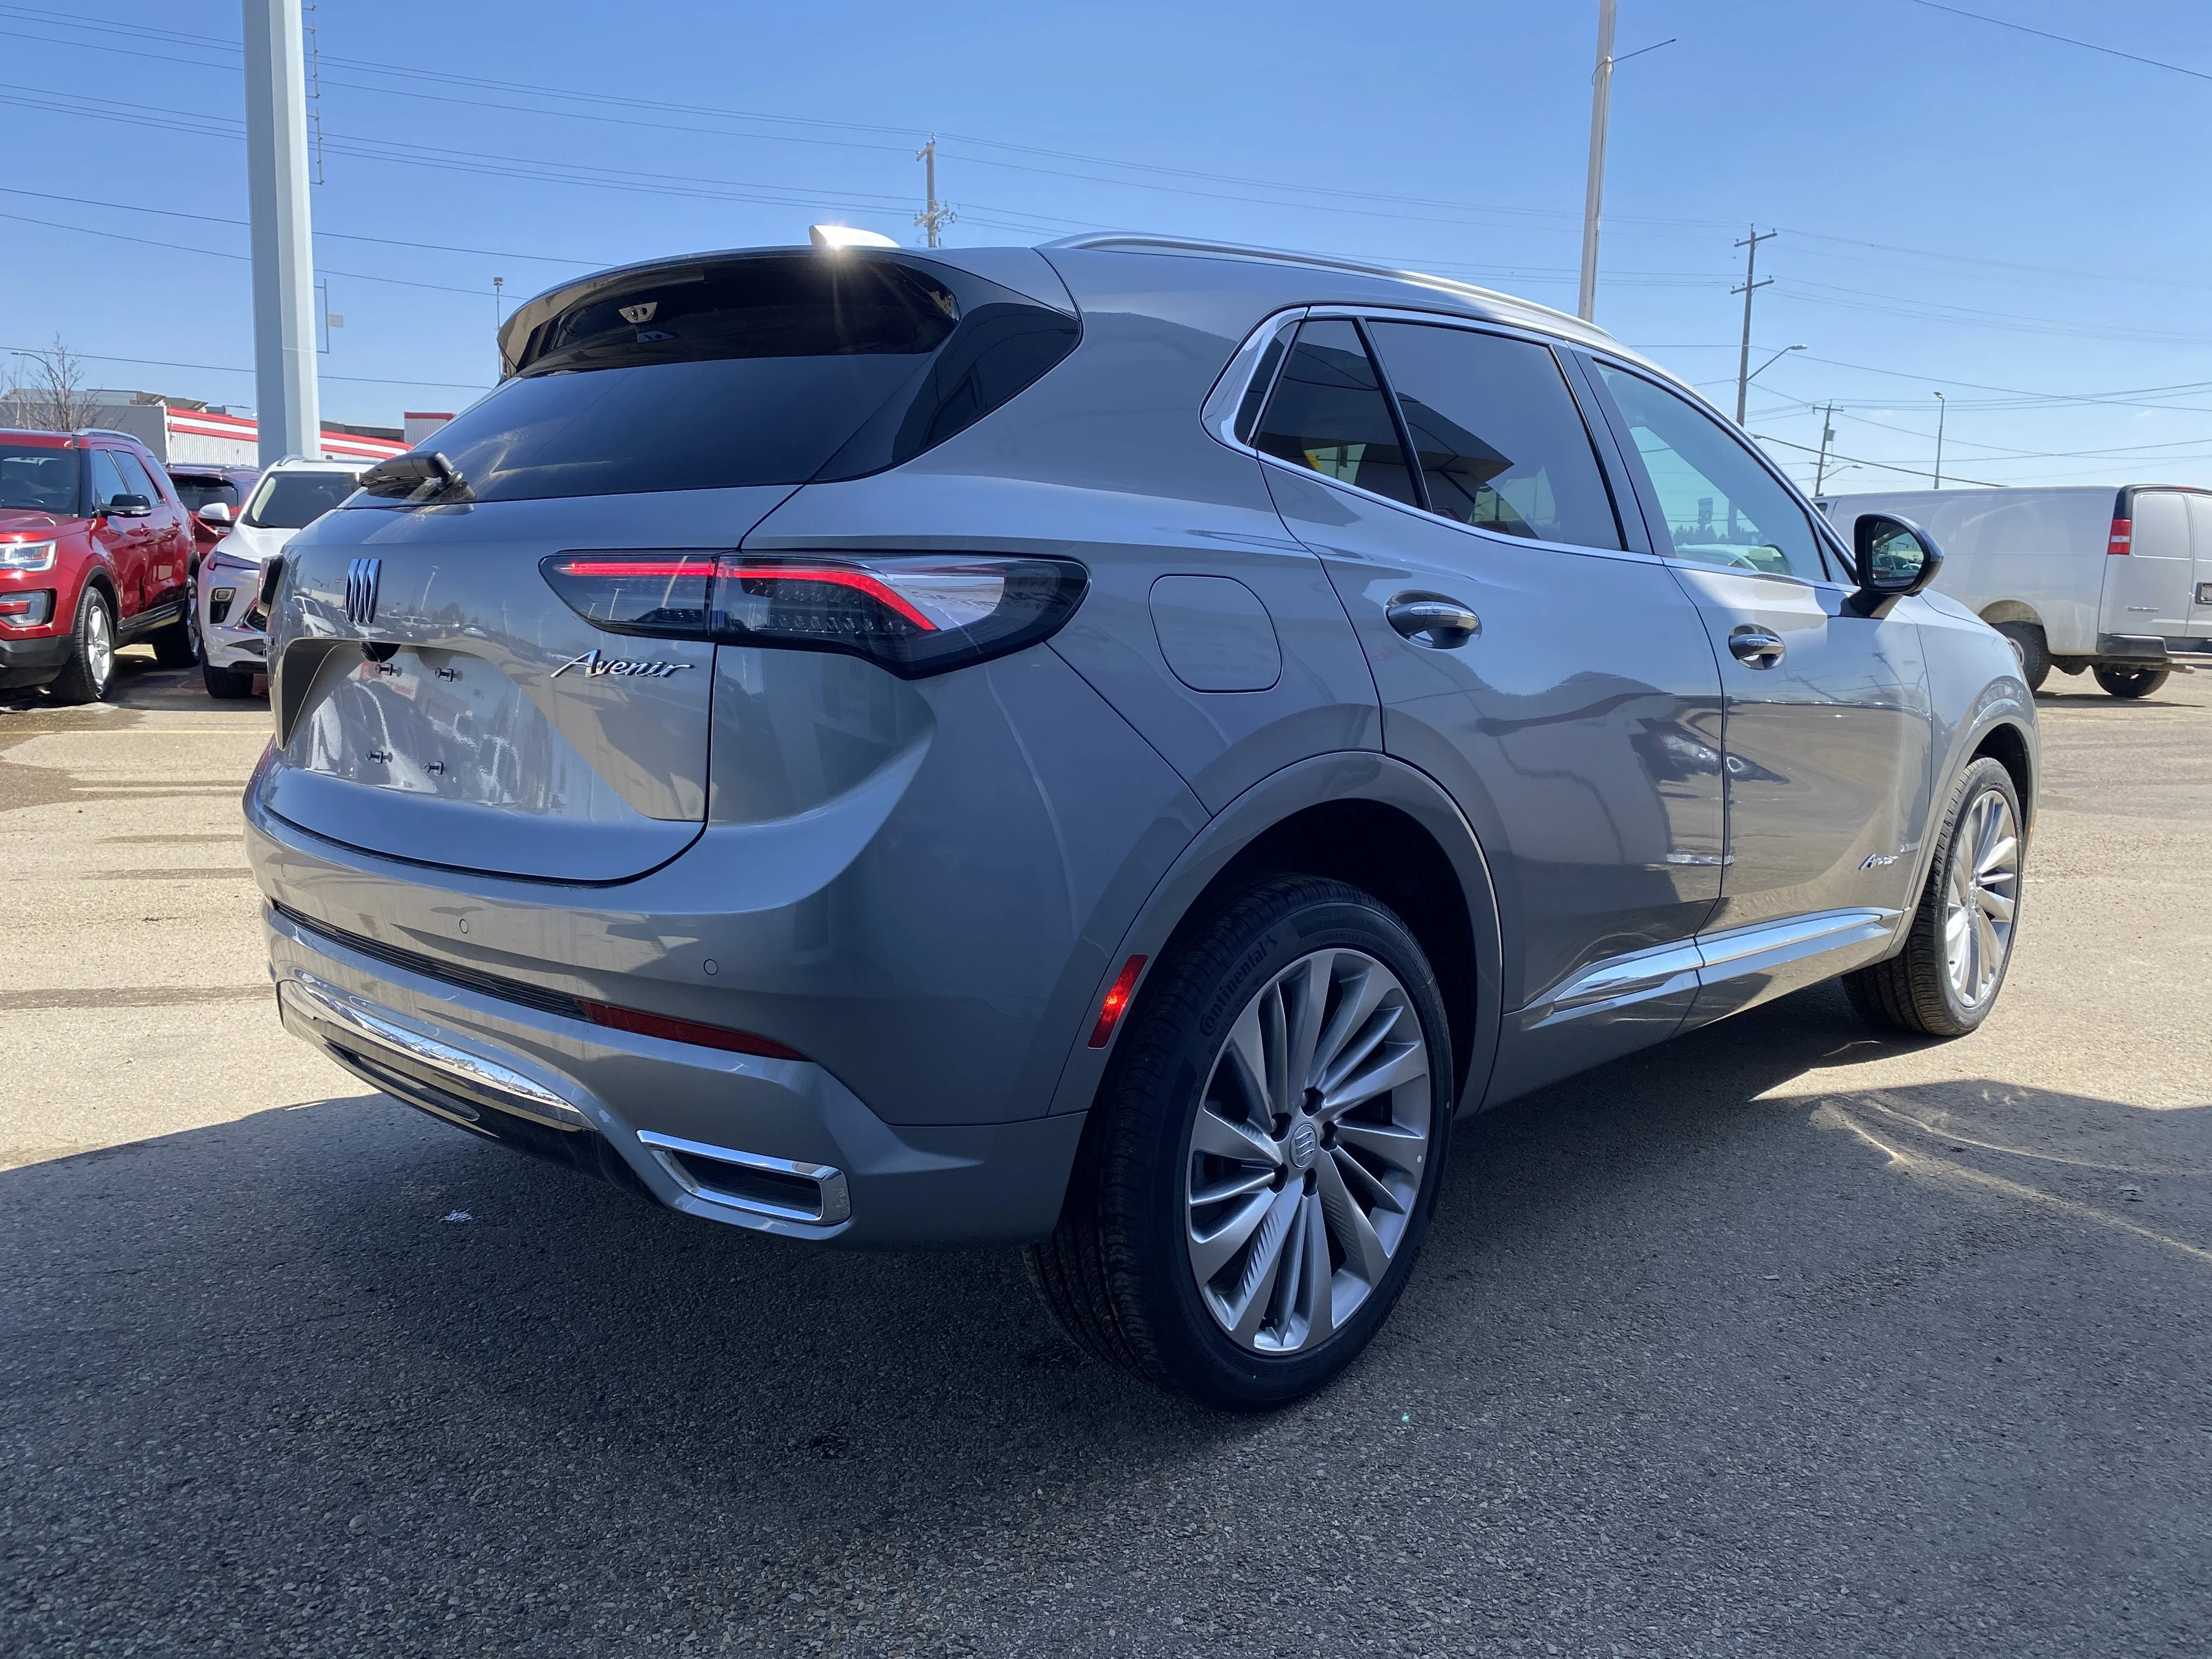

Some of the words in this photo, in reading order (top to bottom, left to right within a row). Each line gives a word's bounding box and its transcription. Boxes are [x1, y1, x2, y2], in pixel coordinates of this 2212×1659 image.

[1699, 510, 1711, 521] 50
[550, 649, 694, 678] Avenir
[1199, 941, 1268, 1037] Continental
